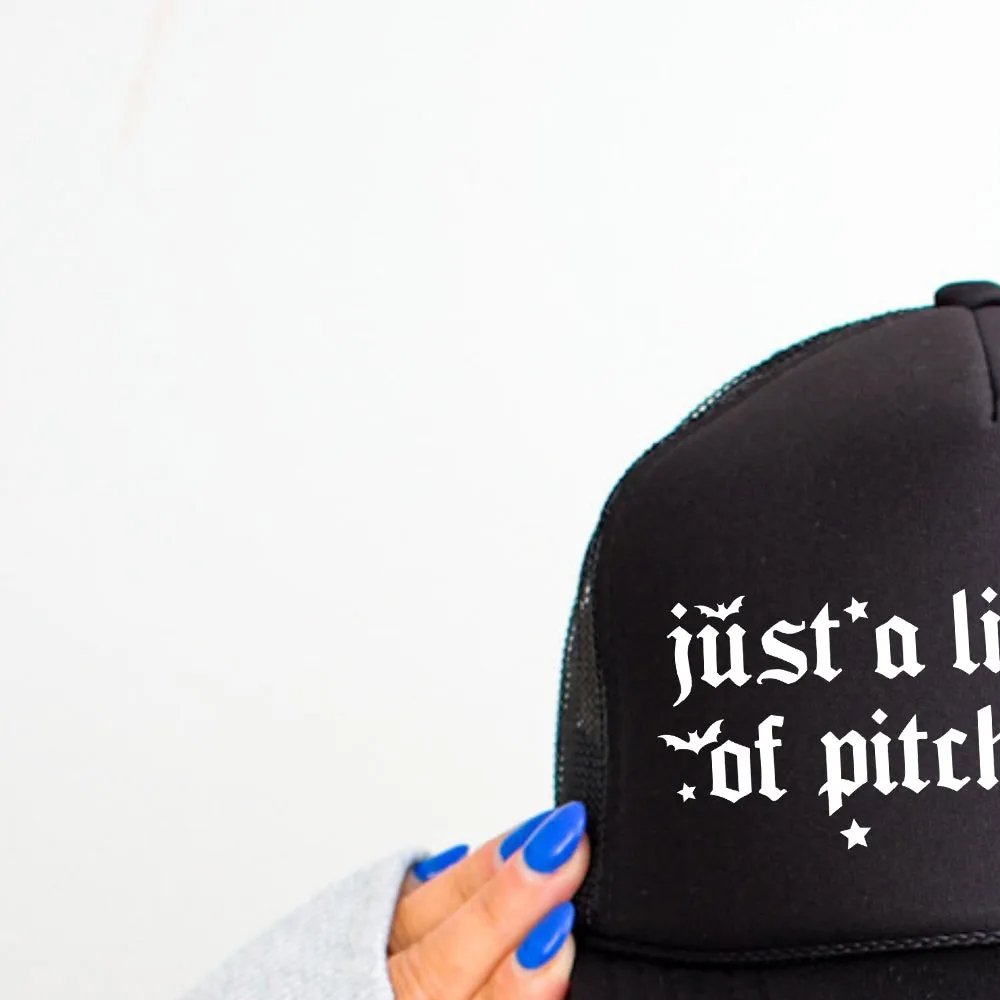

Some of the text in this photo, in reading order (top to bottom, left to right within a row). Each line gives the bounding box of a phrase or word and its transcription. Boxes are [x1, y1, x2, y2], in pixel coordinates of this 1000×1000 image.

[666, 601, 843, 708] just
[874, 614, 926, 680] a
[709, 714, 788, 804] of
